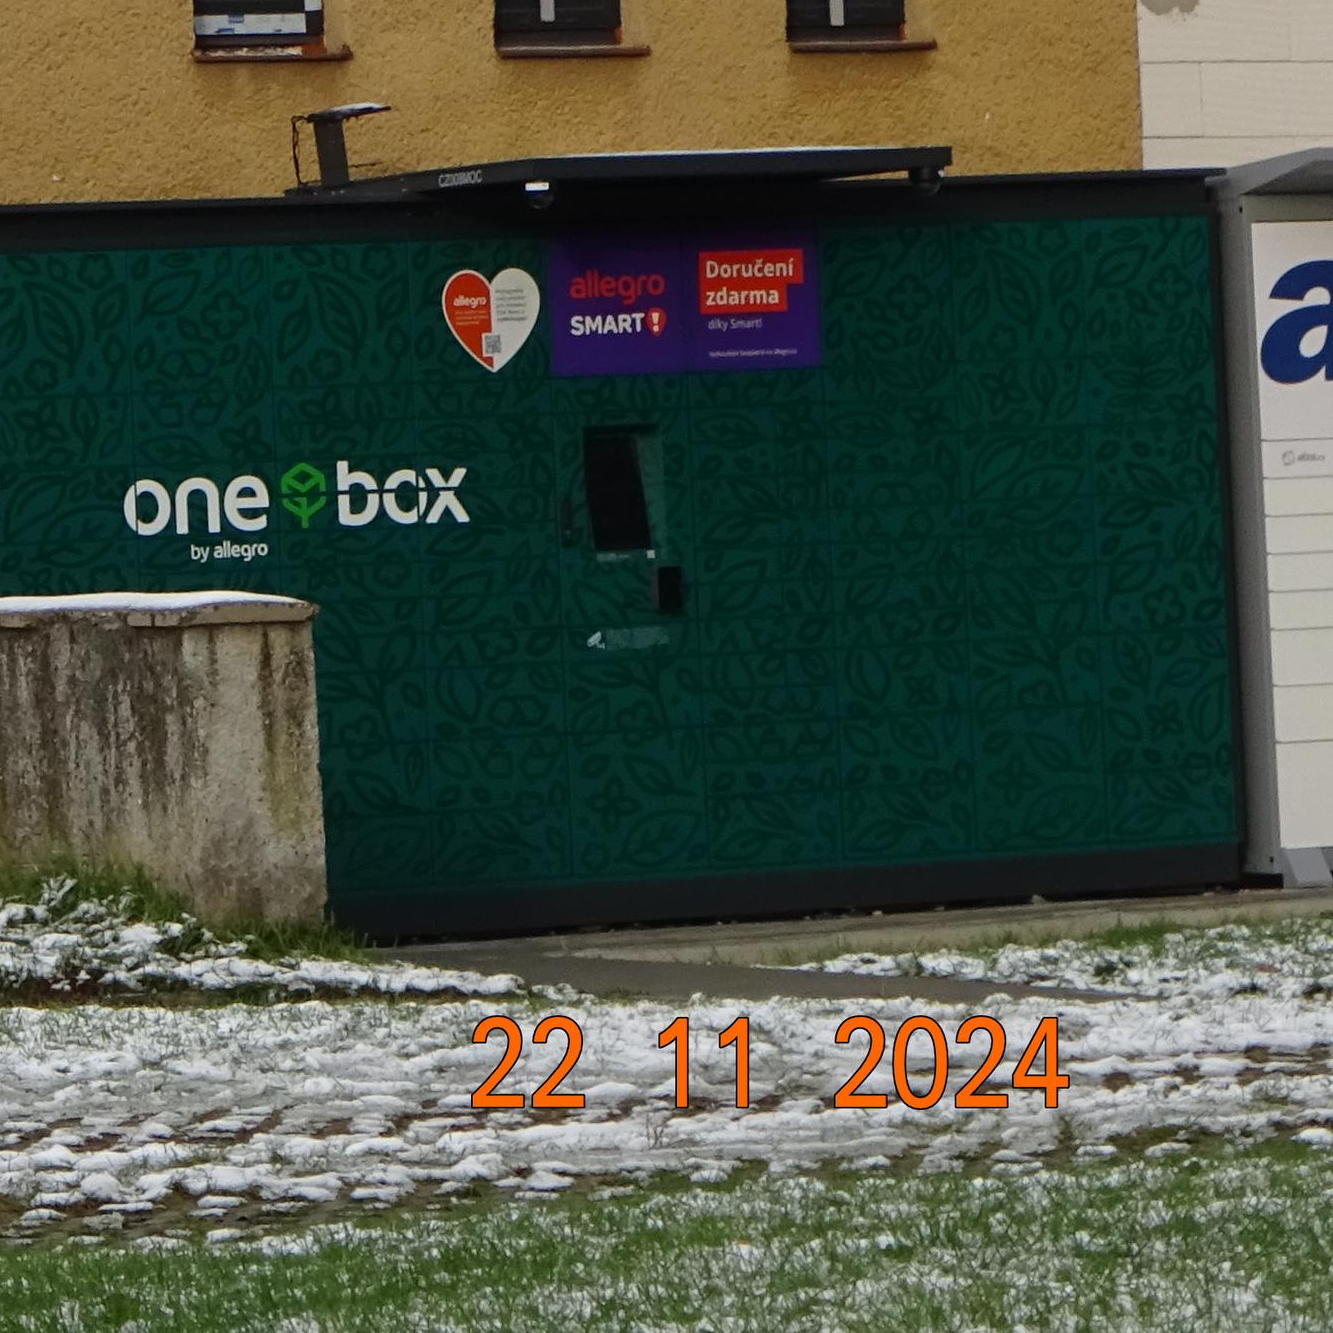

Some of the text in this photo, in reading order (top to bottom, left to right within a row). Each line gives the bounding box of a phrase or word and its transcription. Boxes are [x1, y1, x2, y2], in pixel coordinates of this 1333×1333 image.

[705, 257, 795, 279] Doručení
[570, 269, 666, 305] allegro
[705, 286, 780, 306] zdarma
[453, 294, 487, 309] allegro
[123, 460, 471, 536] one box
[190, 541, 269, 563] by allegro
